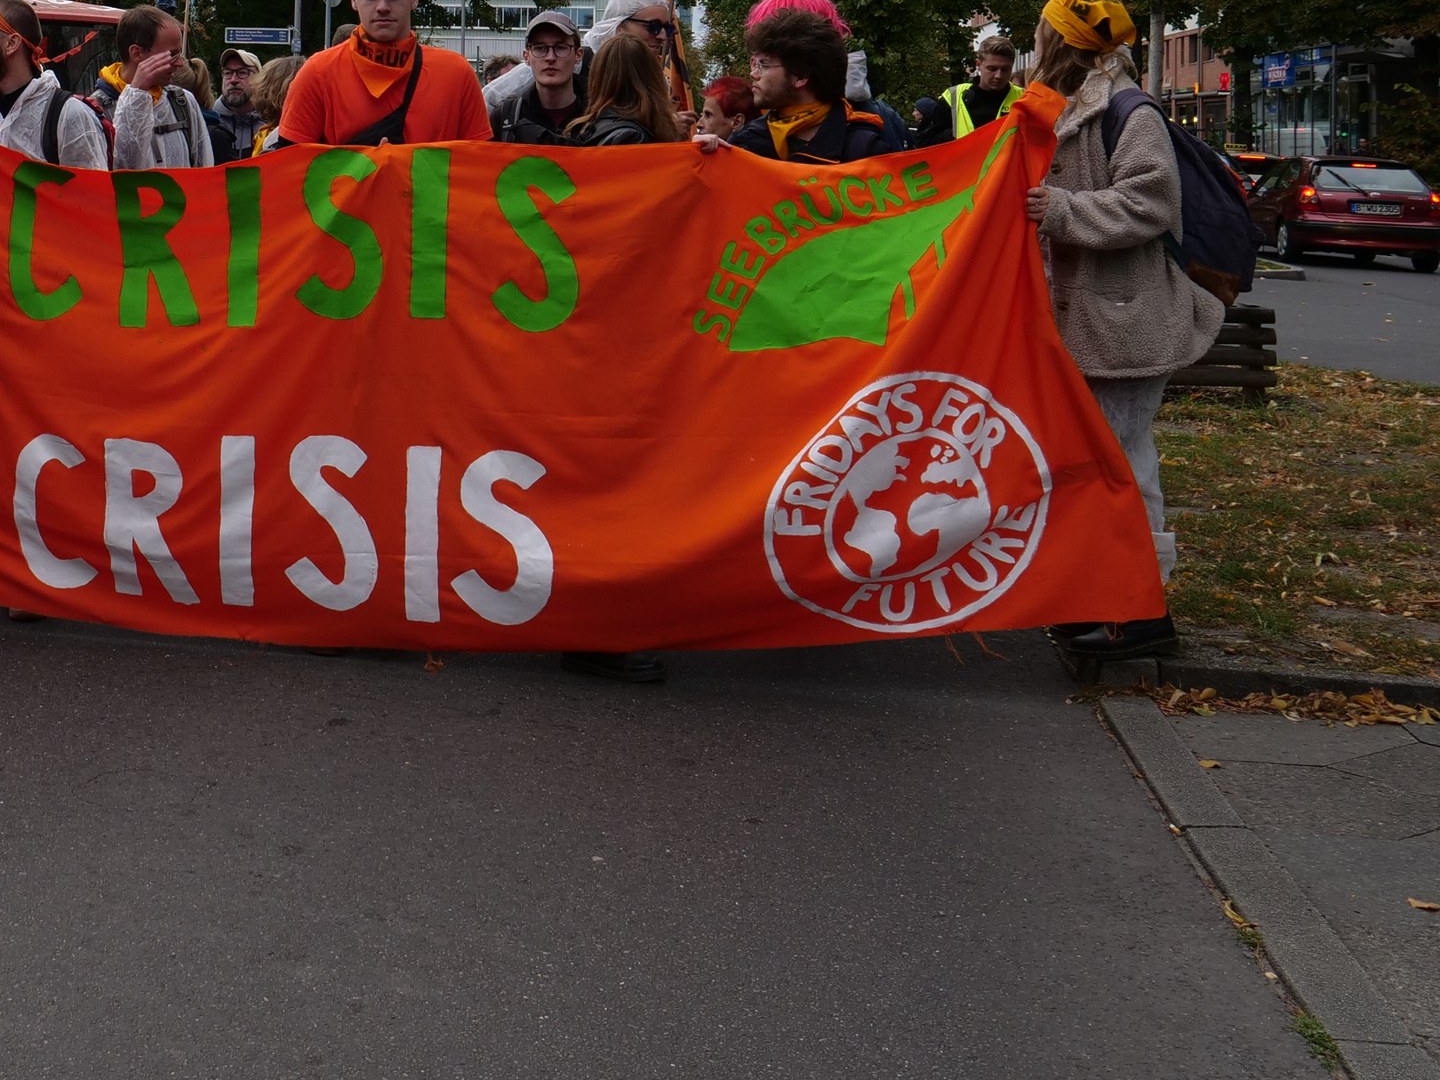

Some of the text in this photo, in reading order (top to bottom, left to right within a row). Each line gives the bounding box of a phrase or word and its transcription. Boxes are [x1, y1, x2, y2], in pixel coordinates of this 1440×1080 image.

[7, 148, 580, 332] CRISIS
[693, 161, 940, 342] SEEBRÜCKE
[12, 433, 555, 626] CRISIS
[774, 383, 1007, 536] FRIDAYS FOR
[842, 501, 1038, 622] FUTURE
